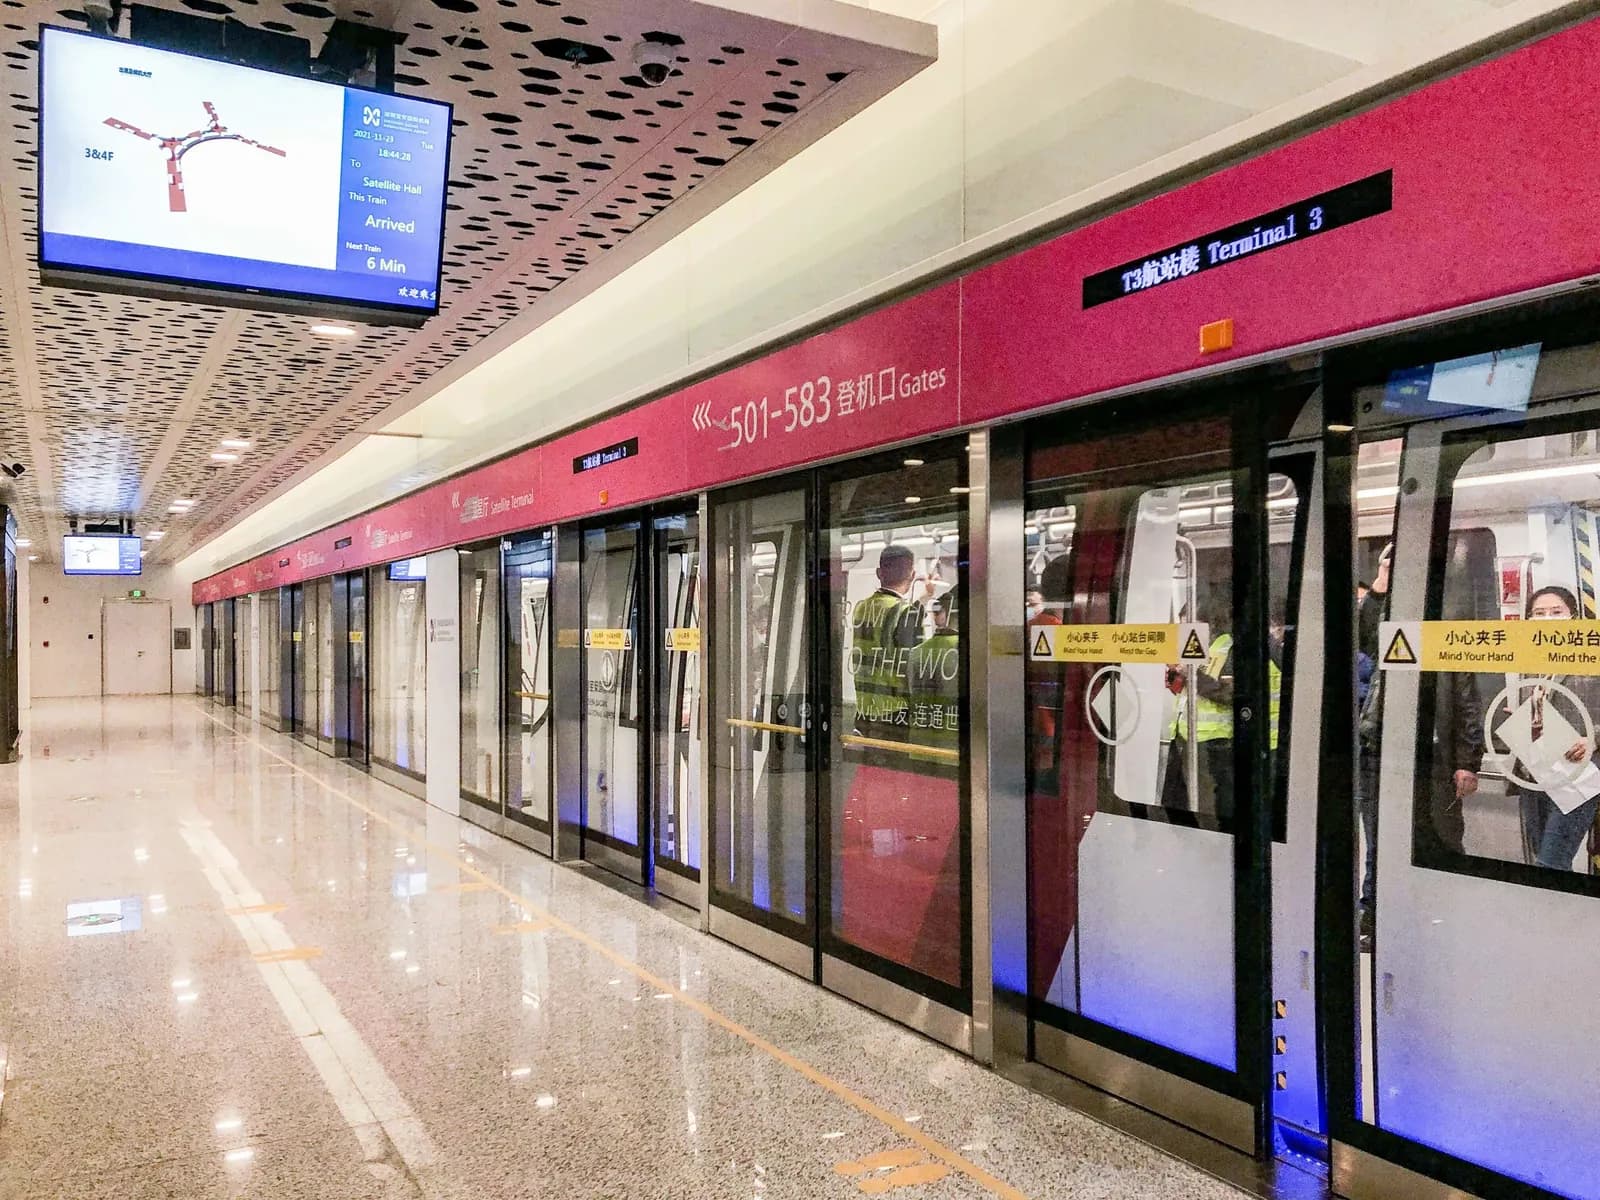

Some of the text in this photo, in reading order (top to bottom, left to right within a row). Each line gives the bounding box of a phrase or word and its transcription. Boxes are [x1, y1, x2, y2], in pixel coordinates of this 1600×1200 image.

[353, 129, 394, 143] 2021-11-23
[85, 147, 114, 161] 3&4F
[379, 148, 411, 161] 18:44:28
[350, 159, 361, 168] To
[363, 176, 422, 195] Satellite Hall
[349, 191, 387, 205] This Train
[365, 214, 415, 234] Arrived
[345, 241, 382, 253] Next Train
[1120, 206, 1323, 293] T3航站楼 Terminal 3
[366, 256, 406, 274] 6 Min
[730, 366, 946, 448] 501-583 登机口 Gates
[511, 488, 534, 510] Terminal
[1066, 631, 1099, 644] 小心夹手
[1445, 630, 1507, 646] 小心夹手
[1532, 630, 1600, 647] 小心站台
[871, 647, 910, 677] THE
[919, 648, 959, 680] WO
[1439, 651, 1514, 662] Mind Your Hand
[1548, 652, 1597, 664] Mind the
[912, 703, 959, 731] 连通世
